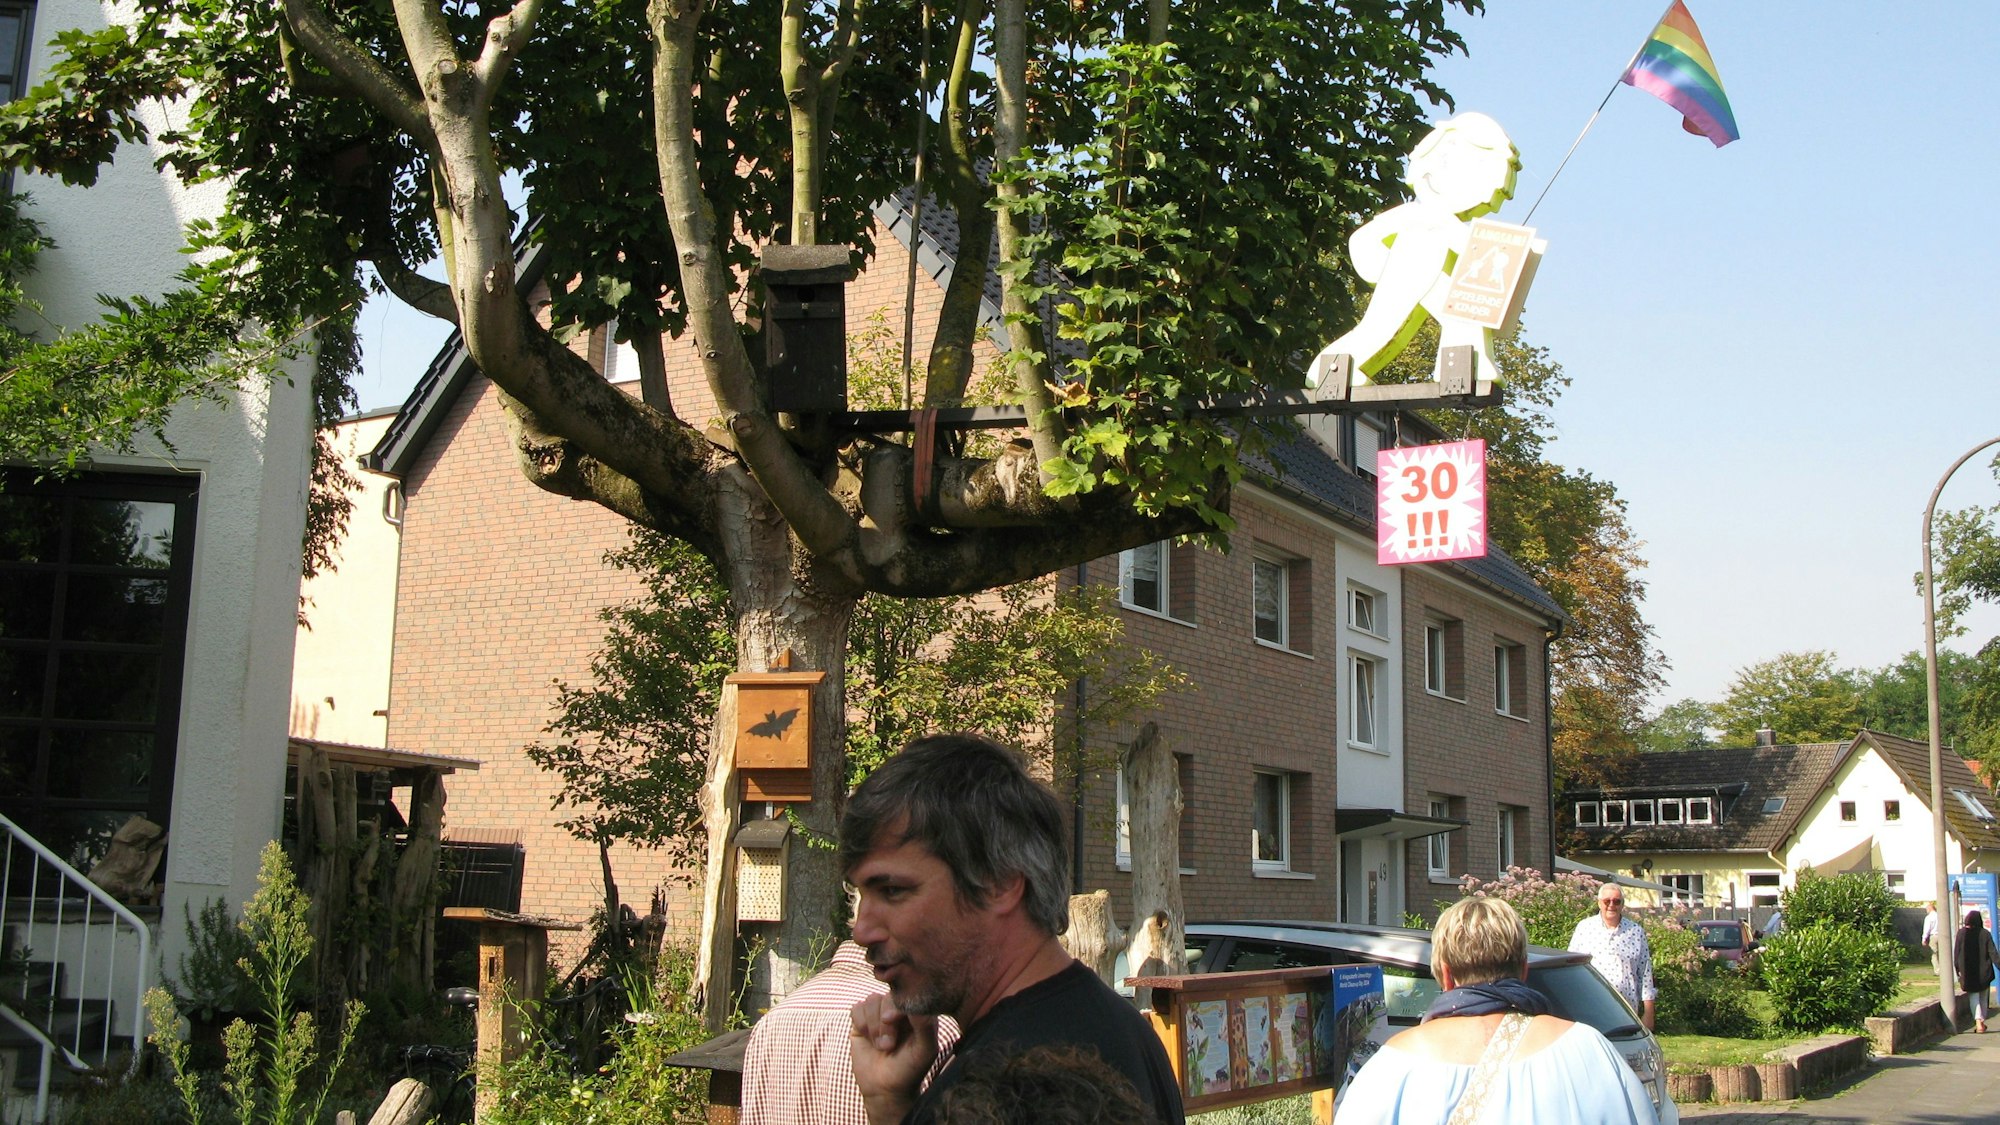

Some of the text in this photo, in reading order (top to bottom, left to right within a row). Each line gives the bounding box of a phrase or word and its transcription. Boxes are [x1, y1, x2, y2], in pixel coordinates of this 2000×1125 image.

[1450, 289, 1504, 308] SPIELENDE
[1454, 302, 1491, 317] KINDER
[1401, 462, 1458, 503] 30
[1407, 509, 1449, 549] !!!
[1379, 862, 1387, 881] 49
